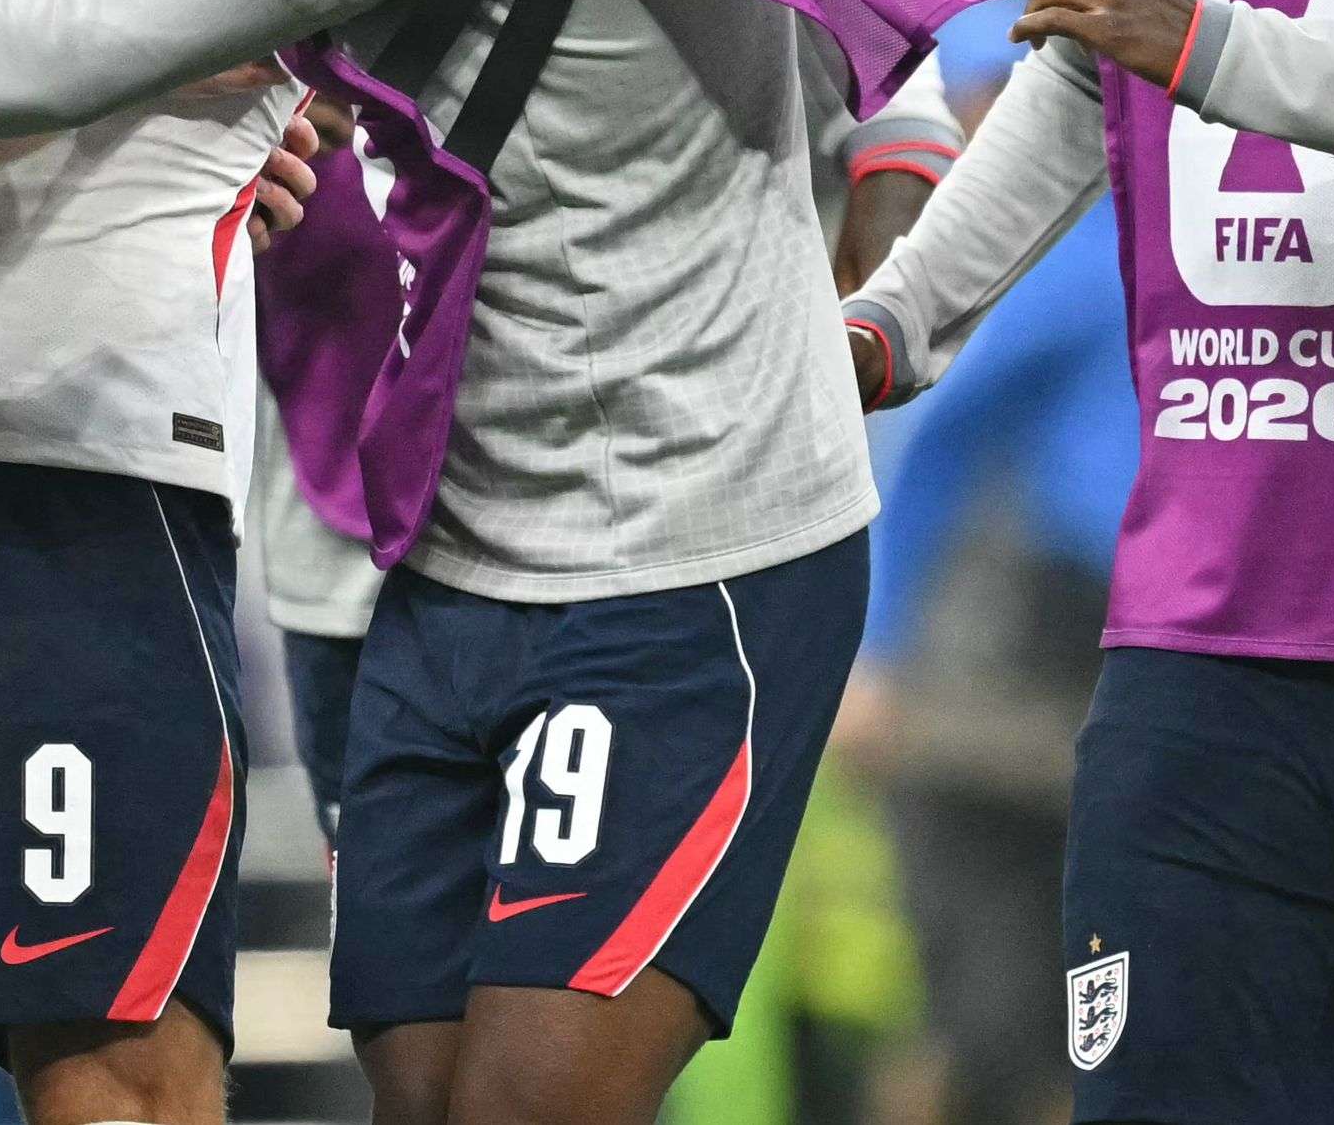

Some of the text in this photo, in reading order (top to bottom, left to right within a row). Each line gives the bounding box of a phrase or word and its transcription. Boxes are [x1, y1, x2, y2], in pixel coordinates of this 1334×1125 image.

[1215, 218, 1313, 263] FIFA
[1170, 328, 1279, 366] WORLD
[23, 743, 95, 905] 9
[498, 704, 615, 867] 19
